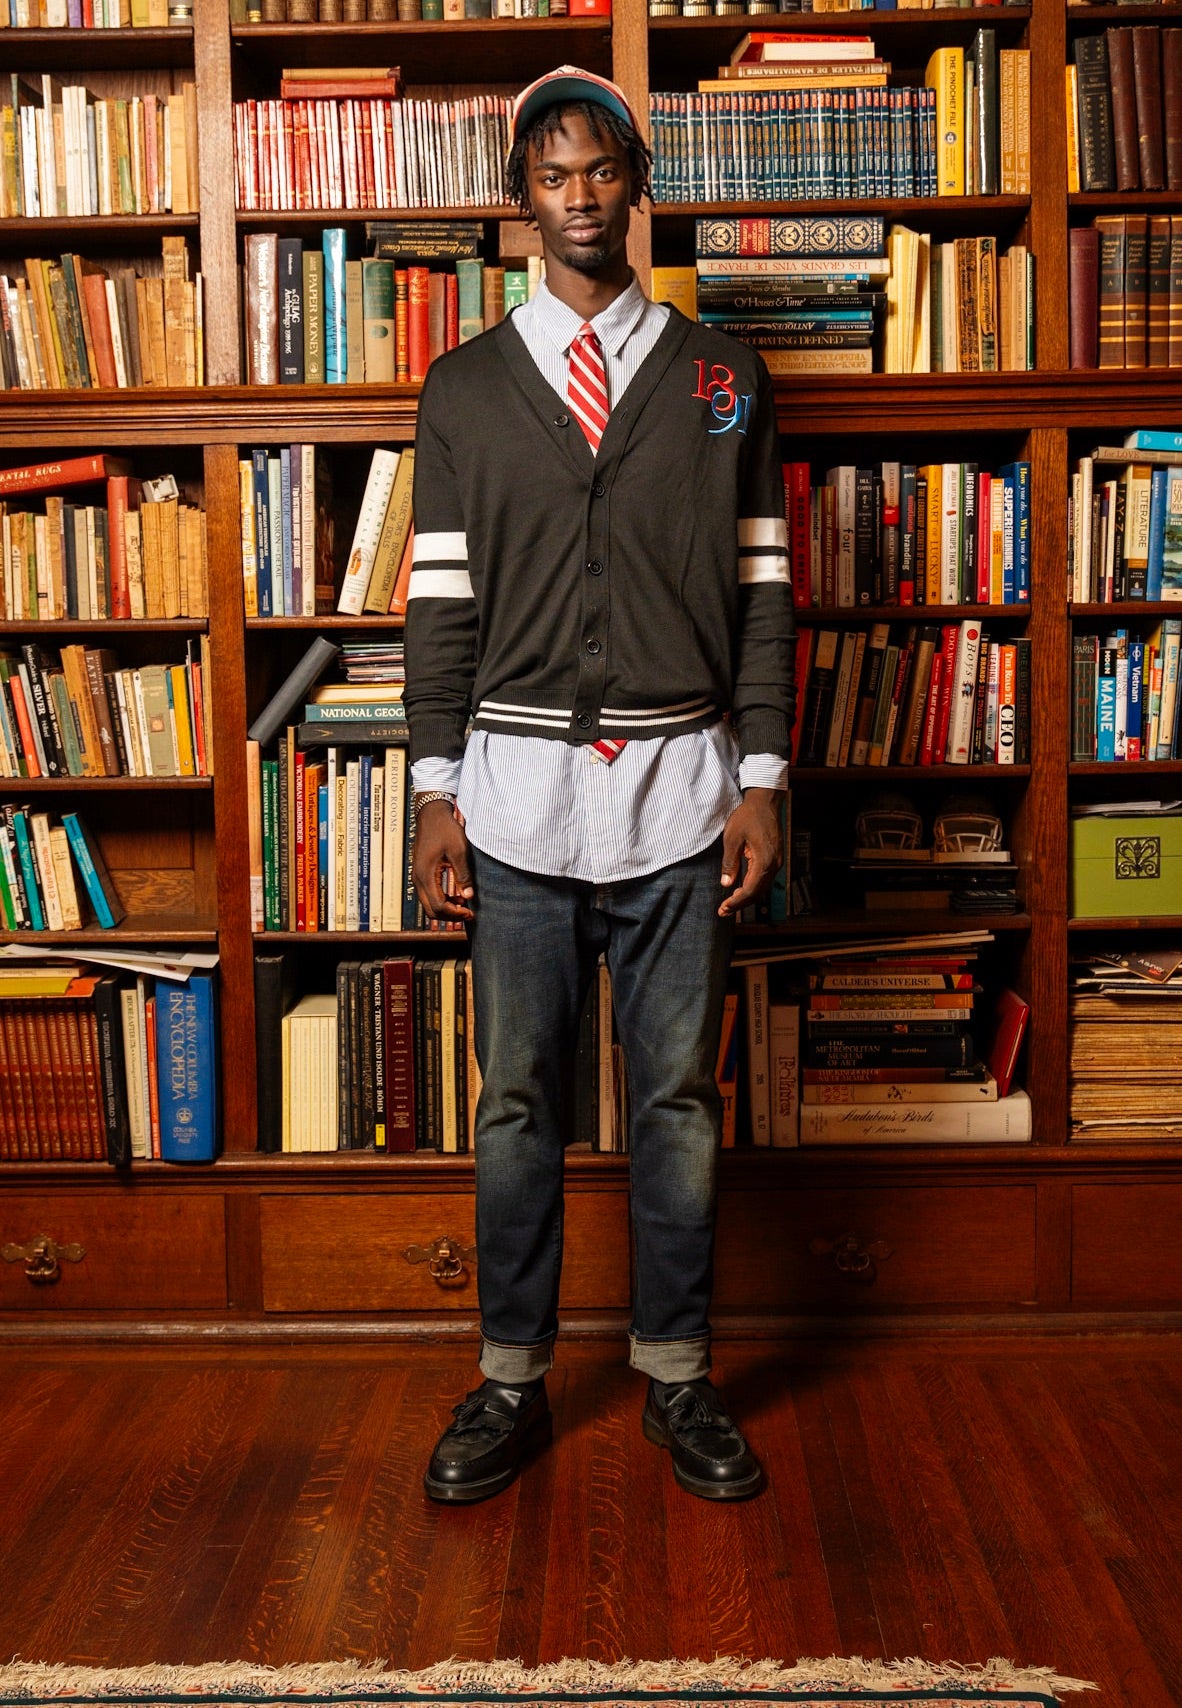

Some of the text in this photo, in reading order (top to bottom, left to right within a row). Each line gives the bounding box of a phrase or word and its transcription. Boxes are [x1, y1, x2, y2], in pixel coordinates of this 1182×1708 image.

[747, 67, 814, 75] MANUALIDADES
[831, 66, 863, 74] TALLER
[707, 262, 867, 271] LES GRANDS VINS DE FRANCE
[292, 295, 300, 323] GULAG
[309, 274, 318, 357] PAPER MONEY
[36, 465, 62, 476] RUGS
[1116, 450, 1139, 458] LOVE
[965, 472, 974, 517] INFONOMICS
[1116, 489, 1125, 533] JAY-Z
[382, 512, 397, 548] OF DOLLS
[1019, 467, 1027, 565] How you What you do
[1139, 490, 1149, 547] LITERATURE
[797, 497, 805, 590] GOOD TO GREAT
[843, 528, 853, 553] four
[902, 534, 913, 570] branding
[930, 487, 938, 585] SMART LUCKY?
[949, 519, 957, 586] STARTUPS THAT WORK
[381, 543, 399, 592] ENCYCLOPEDIA
[965, 642, 976, 677] Boys
[980, 643, 988, 655] BIG
[1073, 646, 1094, 654] PARIS
[86, 656, 98, 695] LATIN
[979, 657, 987, 683] BRANDS
[988, 653, 996, 683] LEADING
[1131, 666, 1141, 703] Vietnam
[33, 684, 45, 716] SILVER
[320, 709, 405, 717] NATIONAL GEOG
[1100, 680, 1113, 733] MAINE
[925, 715, 935, 751] OPPORTUNITY
[1000, 705, 1014, 747] CEO
[307, 791, 316, 825] Antiques
[390, 753, 398, 833] PERIOD ROOMS
[5, 807, 15, 830] Zorro
[337, 779, 345, 857] Decorating Fabric
[307, 833, 316, 863] Jewelry
[348, 825, 356, 854] ROOM
[362, 836, 370, 878] inspirations
[307, 863, 316, 894] Designs
[374, 973, 382, 1006] WAGNER
[832, 978, 930, 986] CALDER'S UNIVERSE
[169, 992, 185, 1100] ENCYCLOPEDIA
[186, 994, 198, 1100] THE NEW COLUMBIA
[375, 1041, 383, 1059] UND
[815, 1045, 880, 1053] METROPOLITAN
[841, 1110, 934, 1122] Audubon's Birds
[863, 1126, 906, 1135] of America
